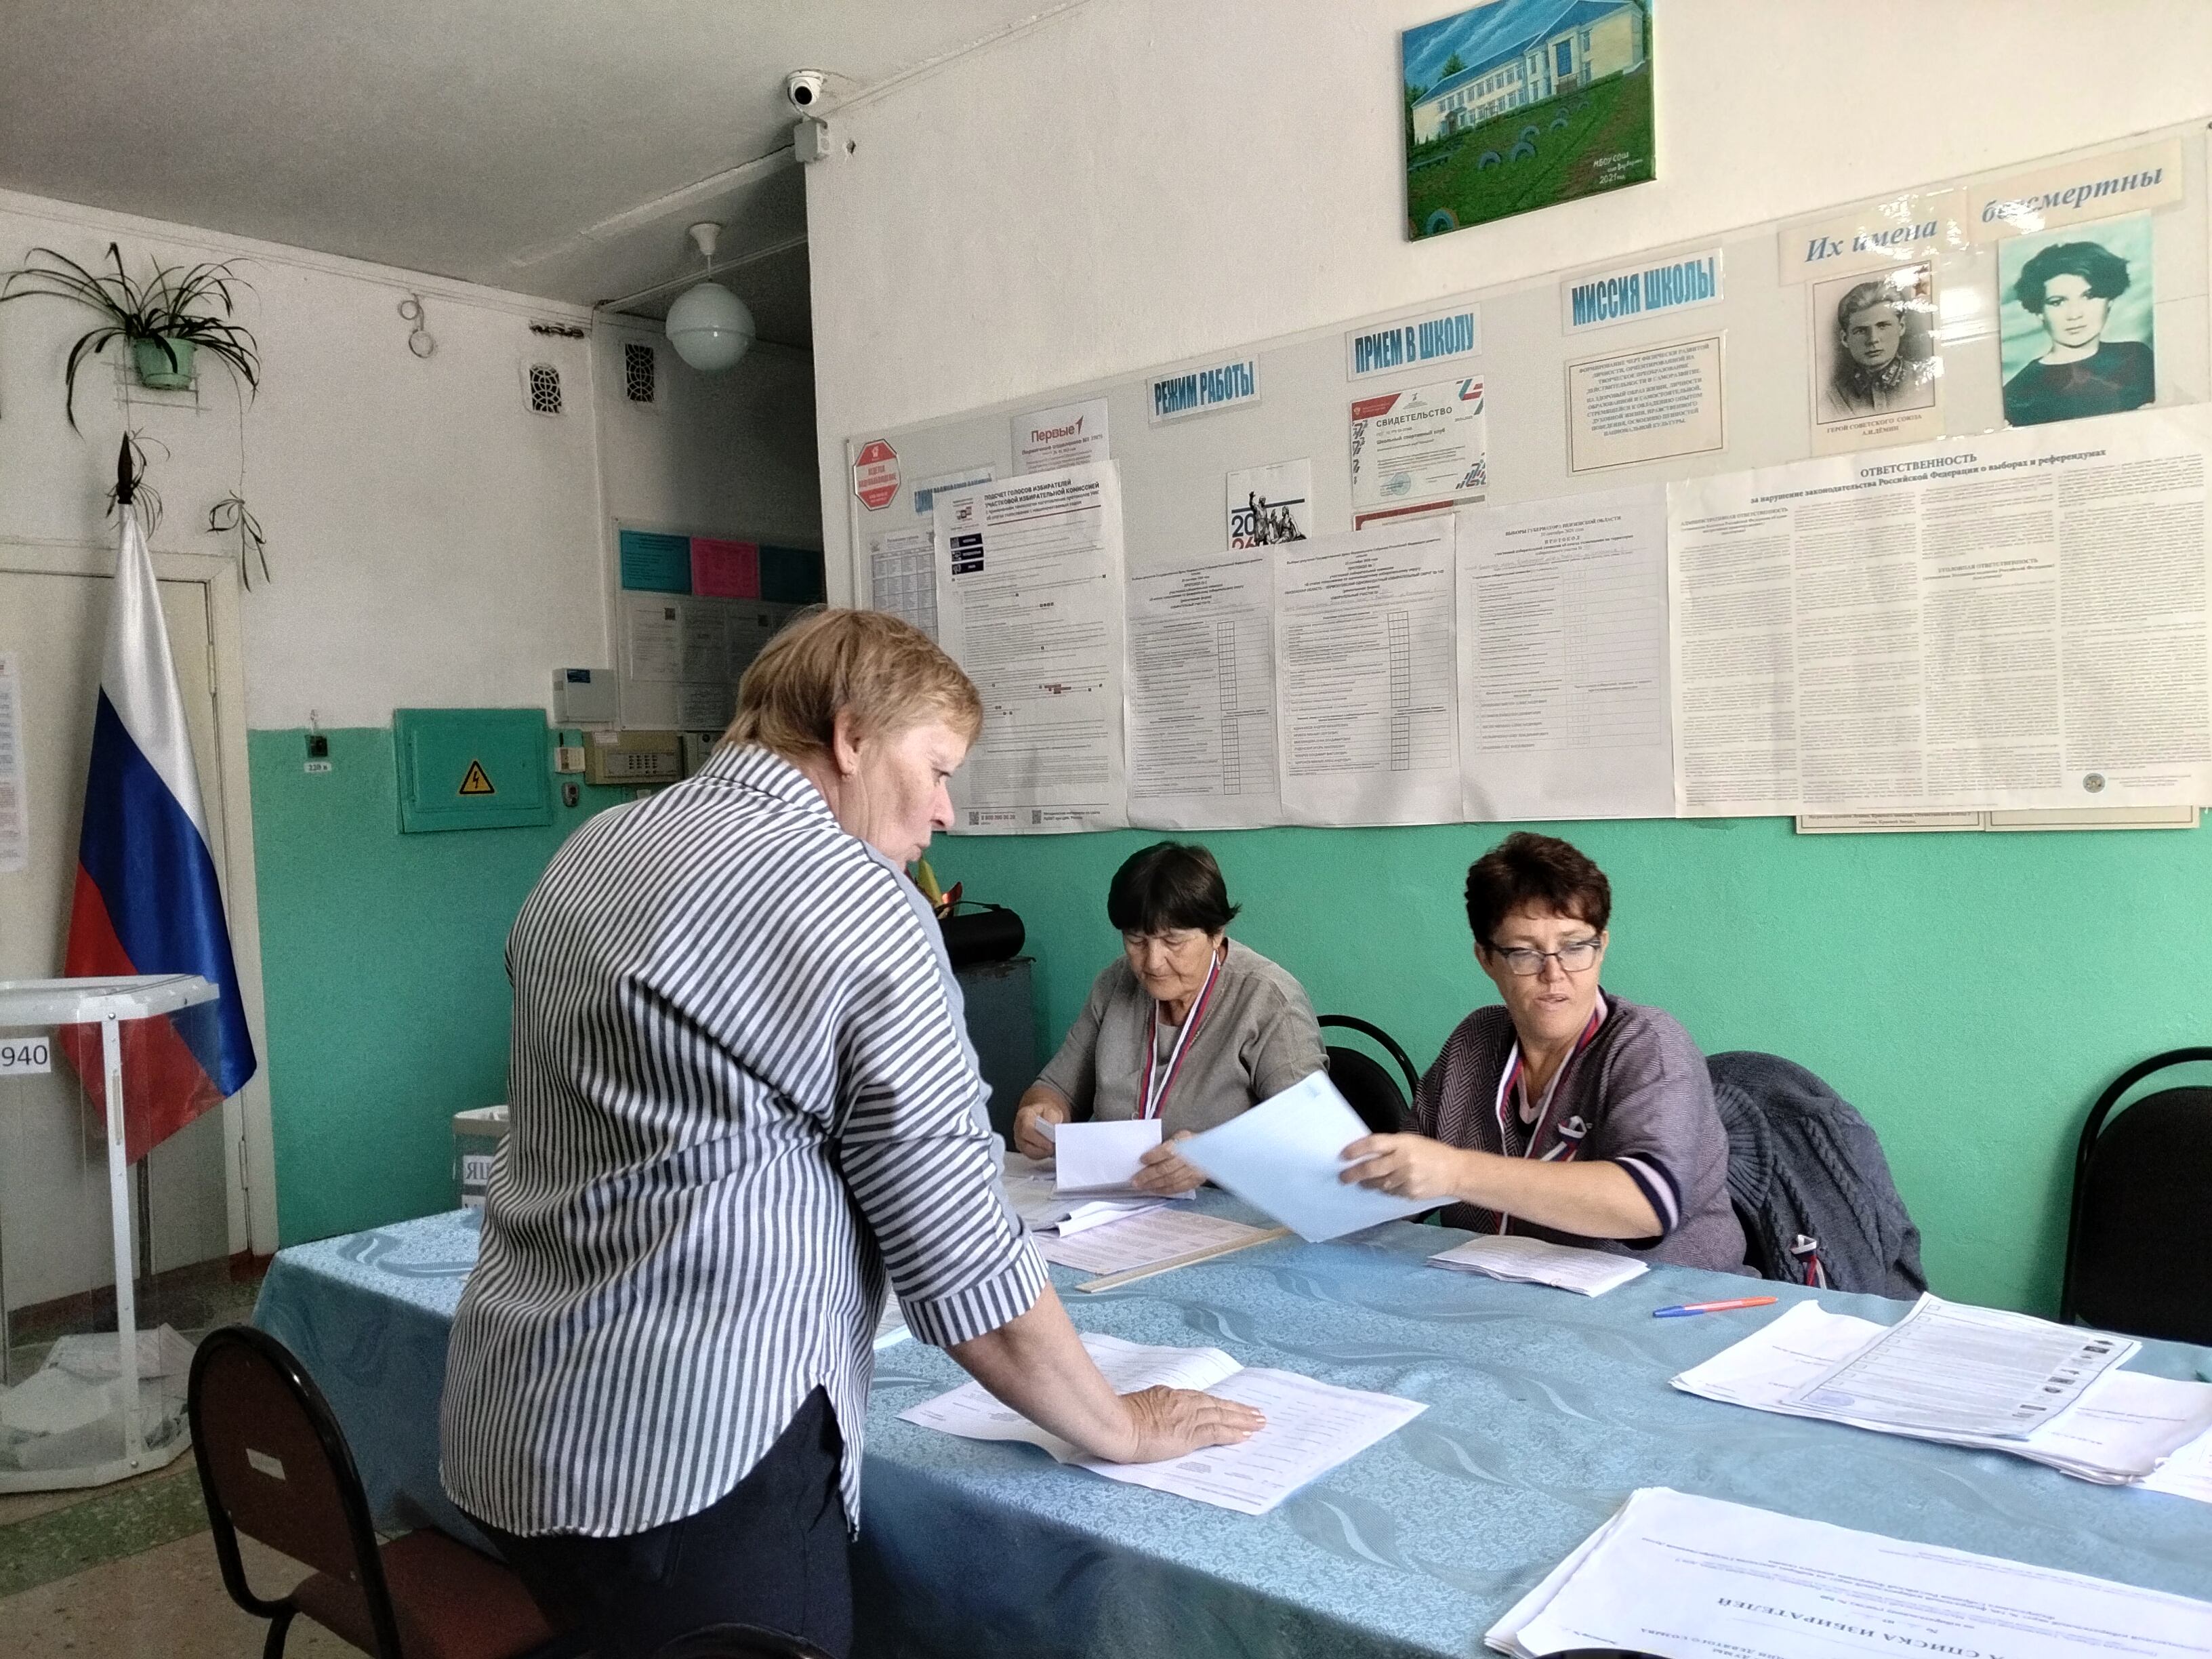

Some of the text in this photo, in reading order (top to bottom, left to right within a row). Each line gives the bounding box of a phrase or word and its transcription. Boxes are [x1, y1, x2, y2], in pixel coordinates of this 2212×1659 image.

[1805, 168, 2163, 262] Их имена бсмертны
[1572, 256, 1715, 326] МИССИЯ ШКОЛЫ
[1355, 312, 1474, 373] ПРИЕМ В ШКОЛУ
[1154, 361, 1254, 415] РЕЖИМ РАБОТЫ
[1376, 407, 1452, 428] СВИДЕТЕЛЬСТВО
[1827, 414, 1922, 433] ГЕРОЙ СОВЕТСКОГО СОЮЗА
[1031, 426, 1075, 443] Первые
[1761, 490, 1803, 504] нарушение
[1805, 481, 1877, 496] законодательства
[1879, 472, 1928, 487] Российской
[1930, 466, 1978, 480] Федерации
[1988, 460, 2028, 472] выборах
[2038, 449, 2106, 467] референдумах
[1860, 453, 1977, 477] ОТВЕТСТВЕННОСТЬ
[985, 495, 1018, 508] УЧАСТКОВОЙ
[1019, 487, 1065, 502] ИЗБИРАТЕЛЬНОЙ
[1066, 481, 1099, 494] КОМИССИЕЙ
[1008, 488, 1032, 496] ГОЛОСОВ
[1033, 478, 1071, 491] ИЗБИРАТЕЛЕЙ
[1231, 513, 1256, 537] 20
[1, 1045, 47, 1066] 940
[1718, 1597, 1980, 1658] СПИСКА ИЗБИРАТЕЛЕЙ
